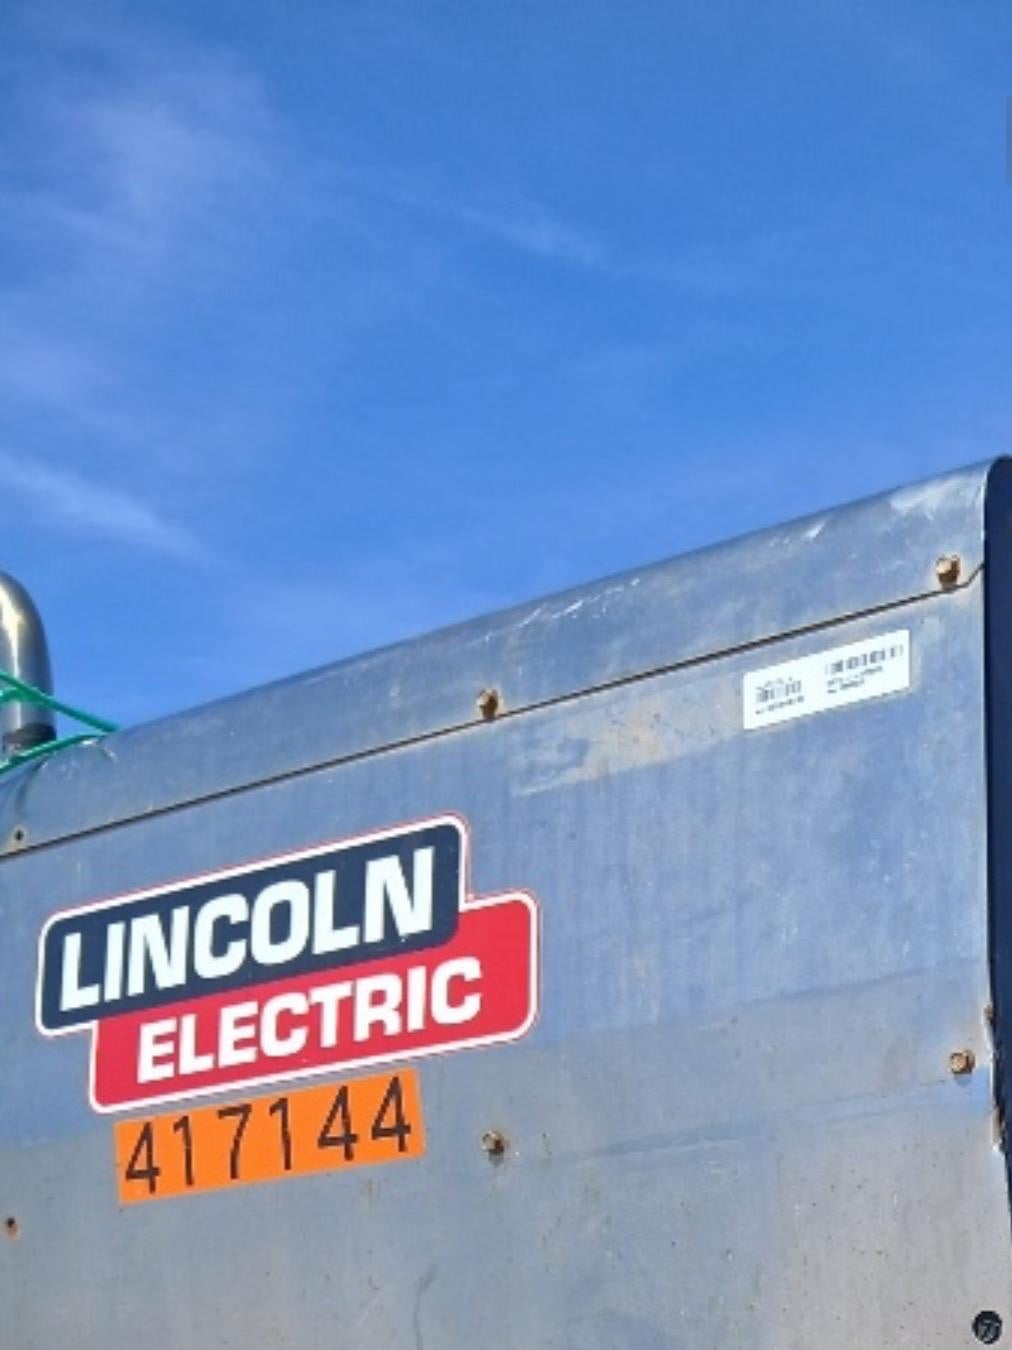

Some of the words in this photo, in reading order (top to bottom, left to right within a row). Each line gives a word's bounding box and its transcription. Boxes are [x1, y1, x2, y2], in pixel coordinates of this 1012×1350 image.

[59, 847, 435, 1013] LINCOLN
[137, 957, 483, 1084] ELECTRIC
[125, 1075, 412, 1194] 417144
